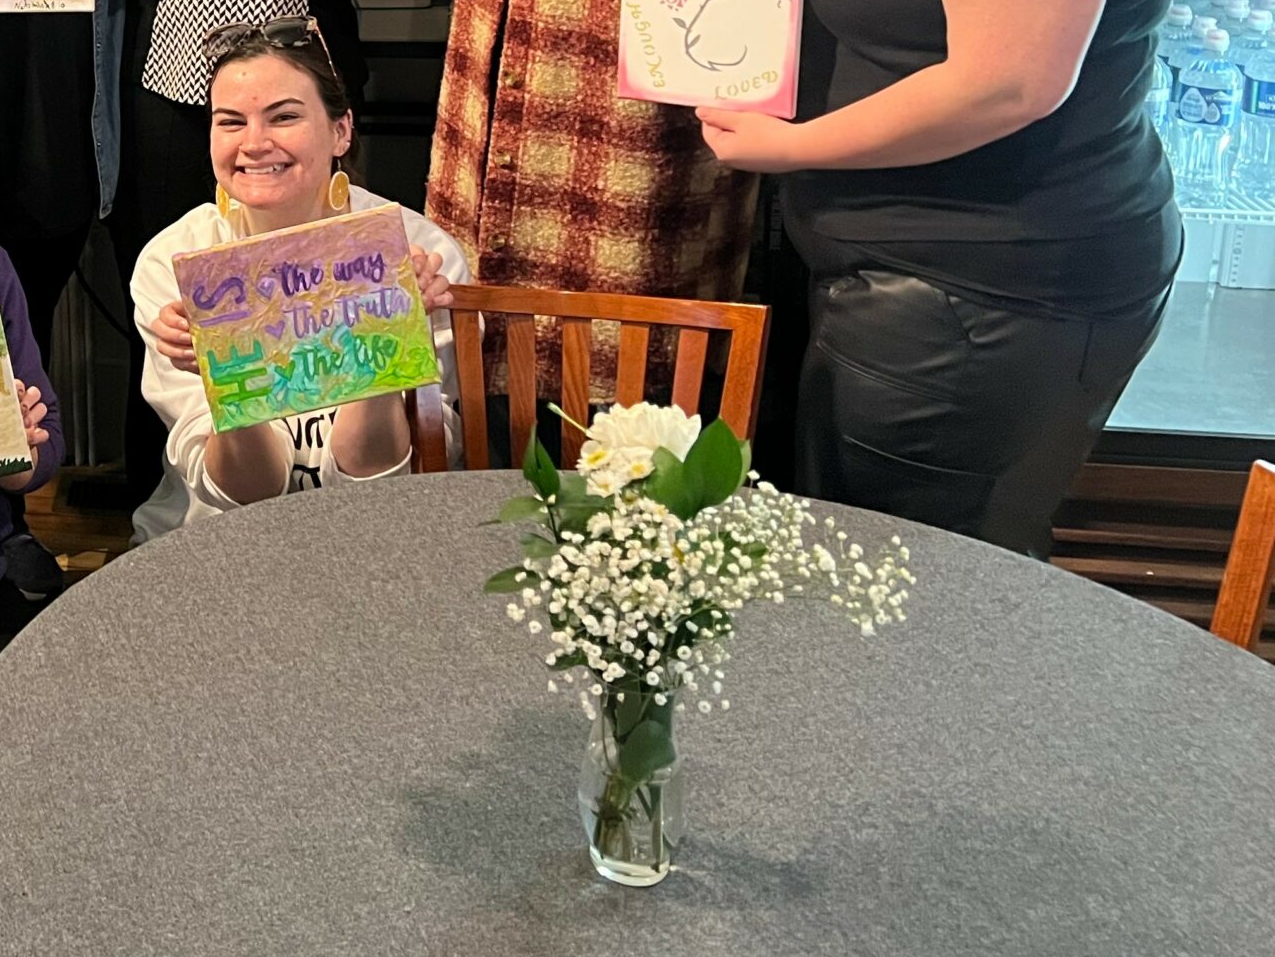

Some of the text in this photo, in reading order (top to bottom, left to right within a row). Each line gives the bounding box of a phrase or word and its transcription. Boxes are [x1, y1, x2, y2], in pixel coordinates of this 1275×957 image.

[626, 2, 666, 89] ENOUGH
[714, 70, 779, 101] LOVED
[273, 251, 385, 295] the way
[282, 287, 411, 339] the truth
[289, 333, 400, 381] the life
